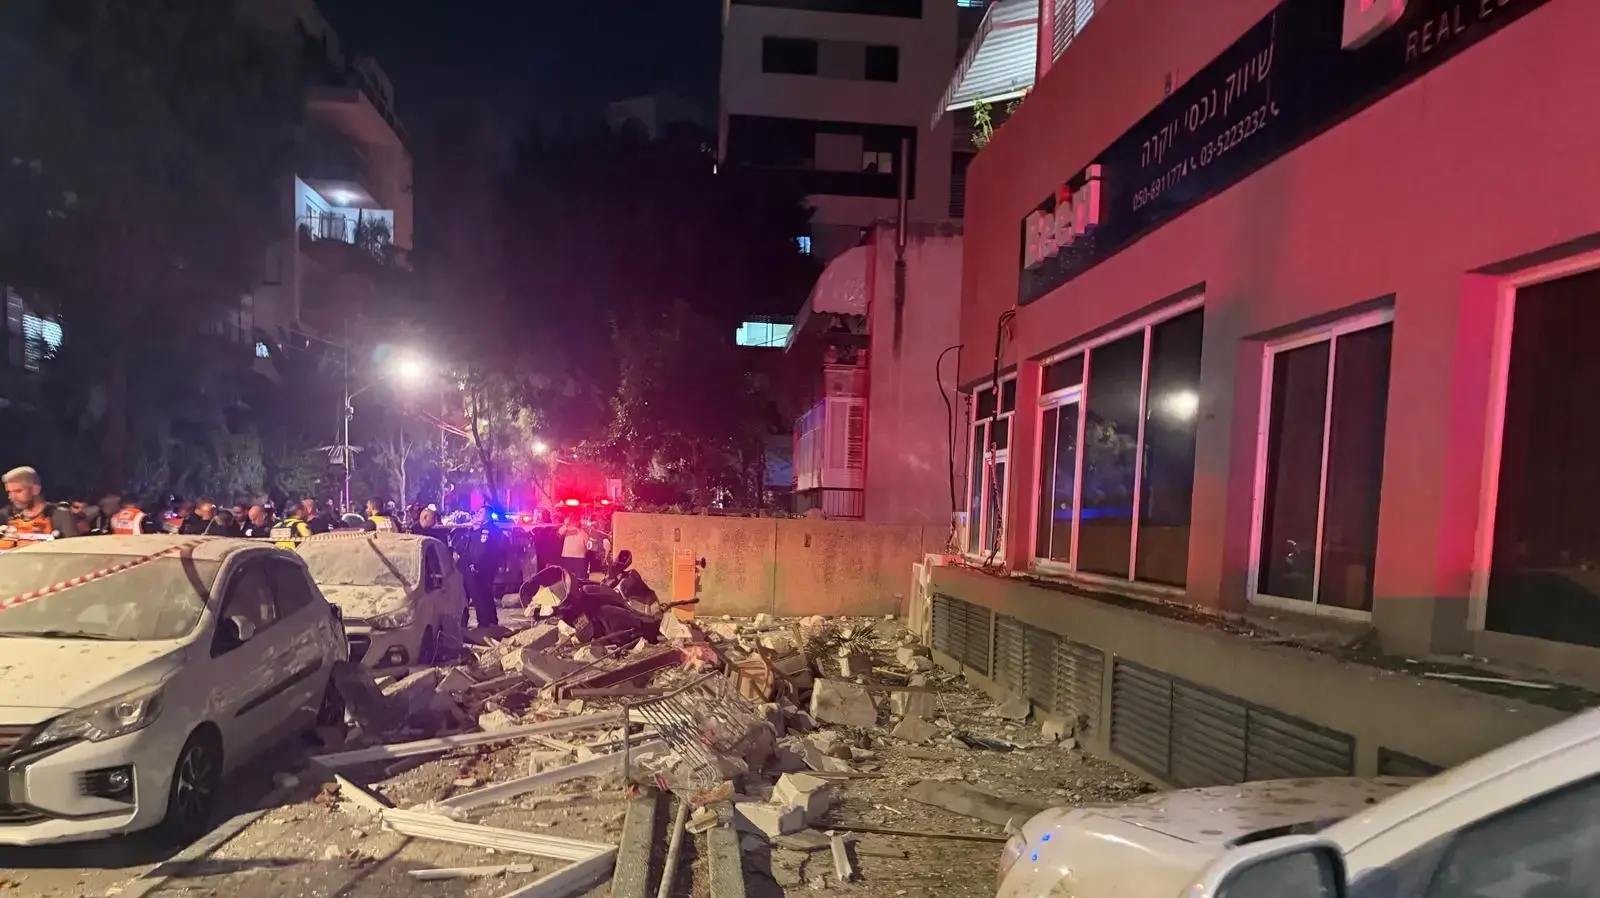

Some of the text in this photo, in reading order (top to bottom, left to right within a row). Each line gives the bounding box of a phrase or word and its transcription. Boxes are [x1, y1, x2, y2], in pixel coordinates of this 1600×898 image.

[1405, 4, 1466, 63] REAL
[1479, 0, 1509, 19] E
[1141, 43, 1274, 168] שיווק נכסי יוקרה
[1200, 105, 1267, 167] 03-5223232
